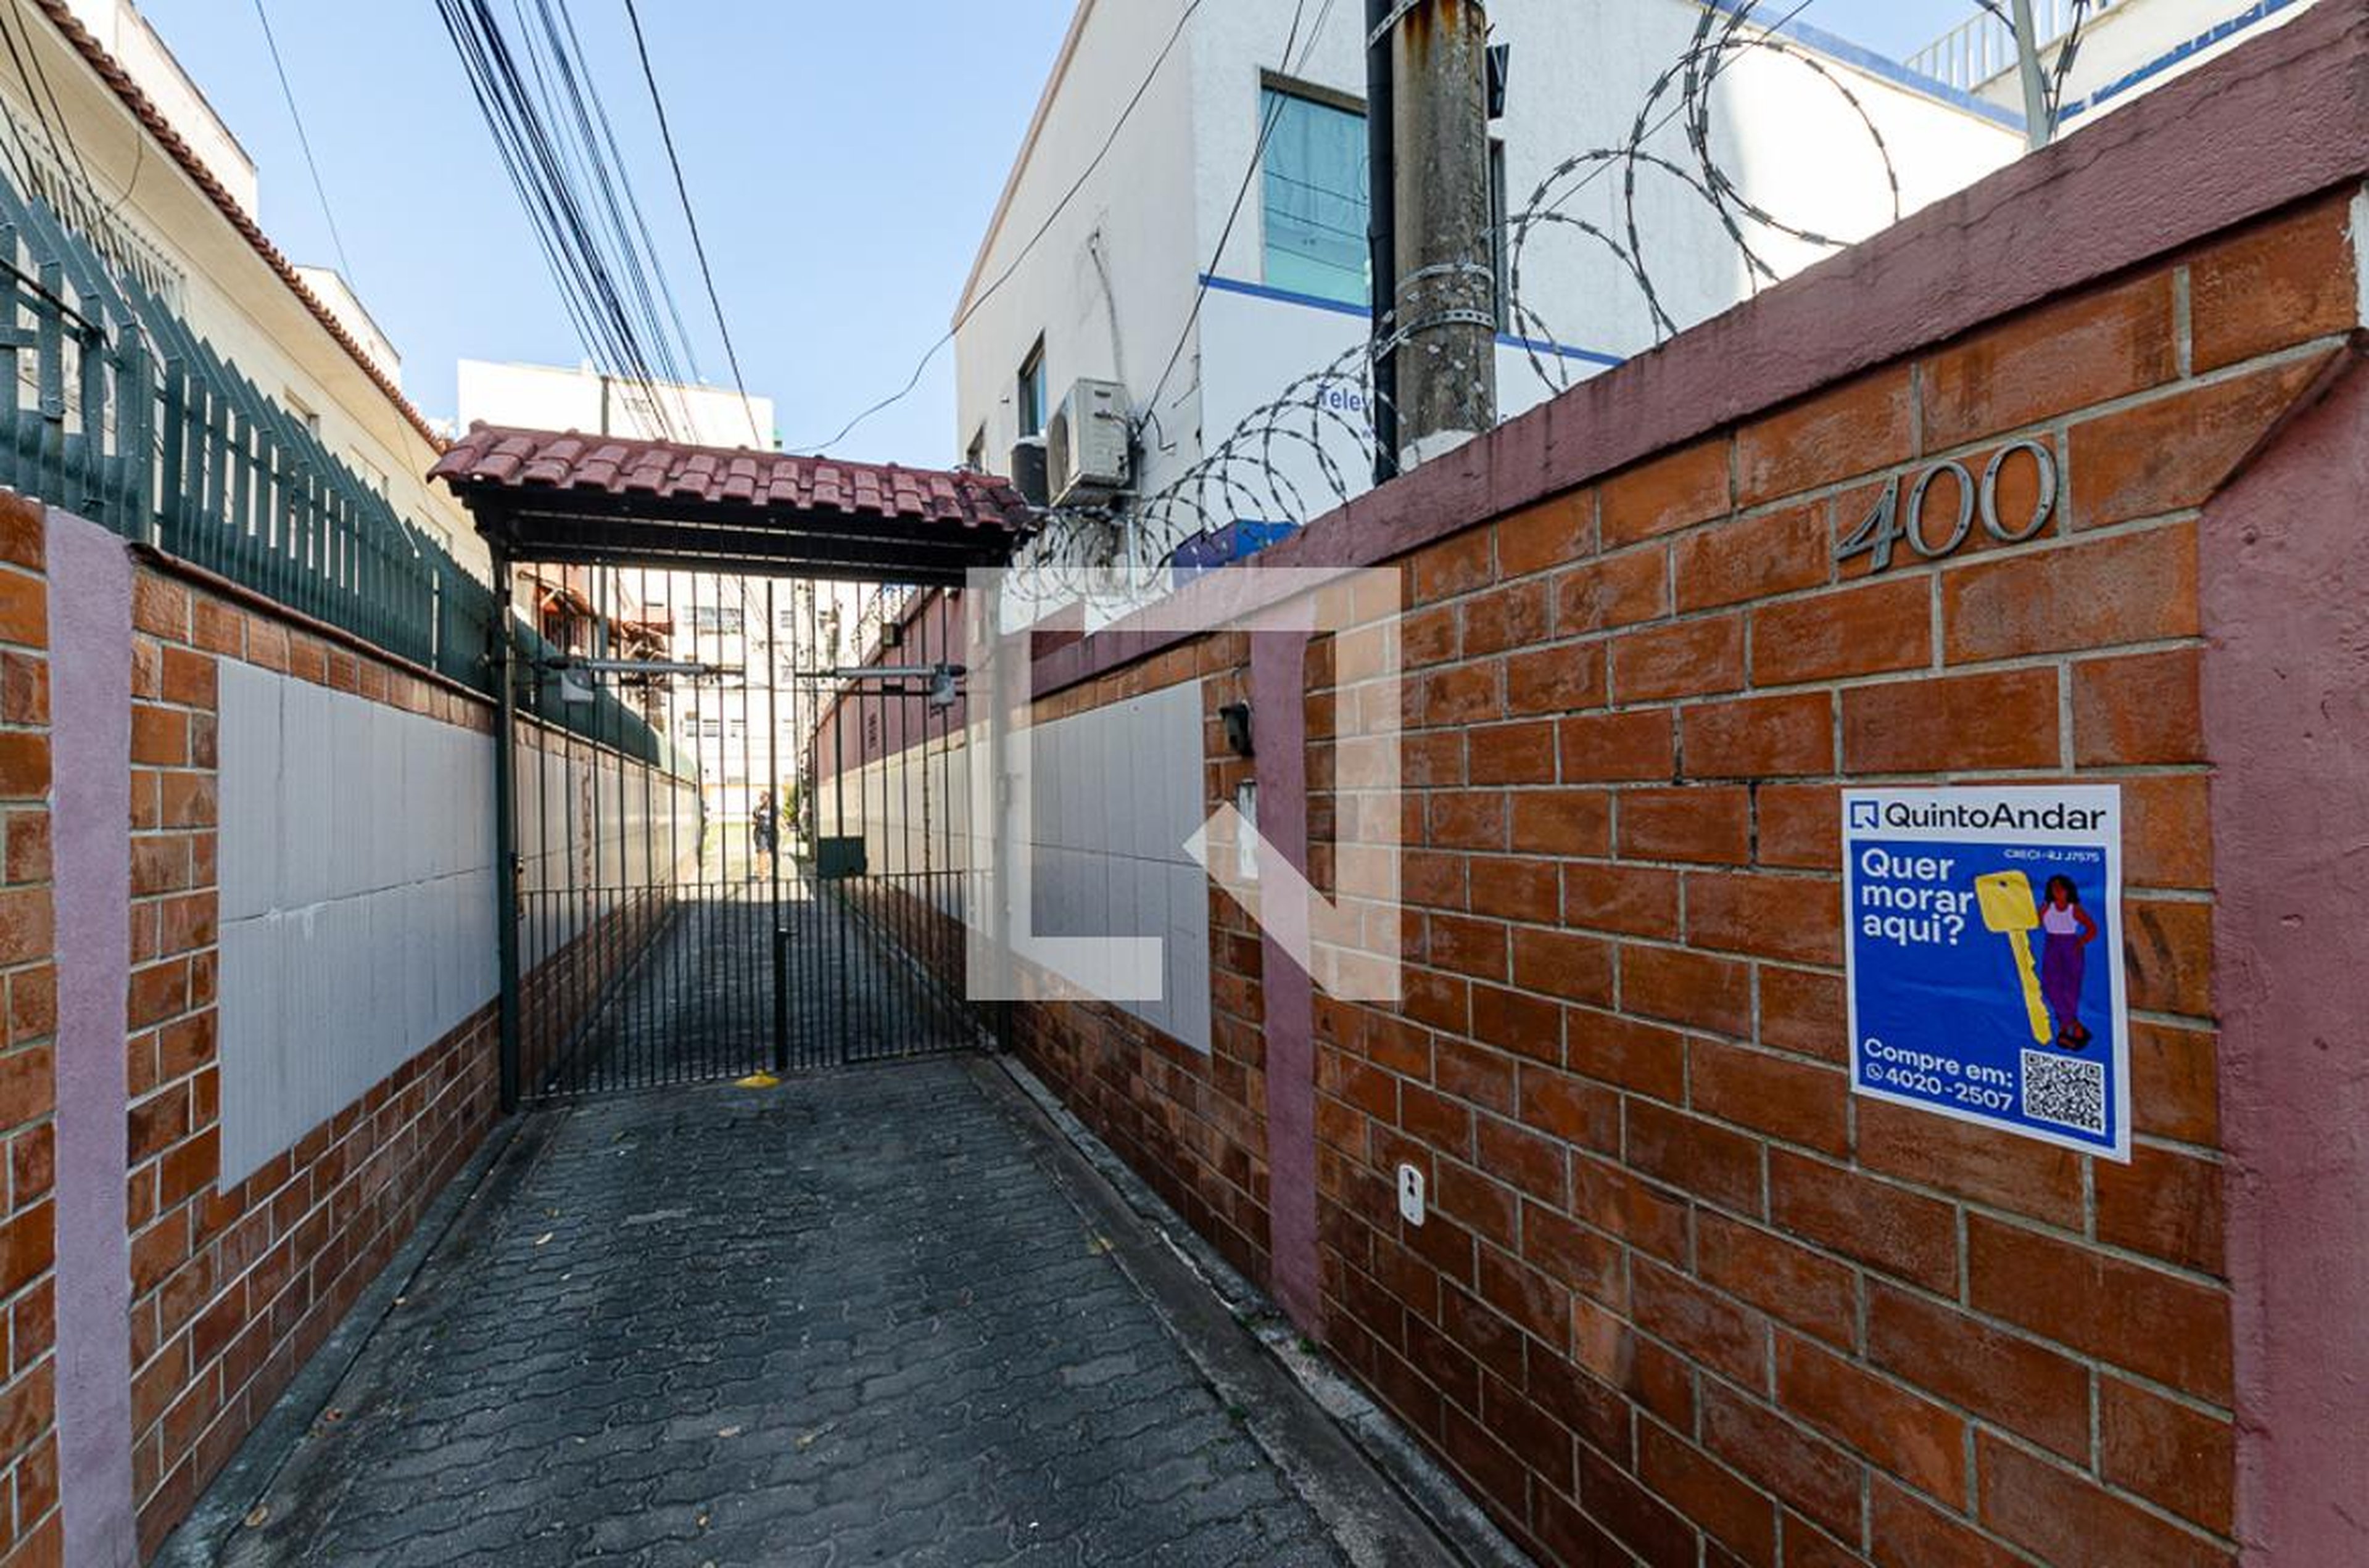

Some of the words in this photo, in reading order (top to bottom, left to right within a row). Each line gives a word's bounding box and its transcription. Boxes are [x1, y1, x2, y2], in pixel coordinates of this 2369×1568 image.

[1837, 439, 2058, 572] 400
[1885, 803, 2107, 830] QuintoAndar
[1861, 848, 1954, 881] Quer
[1862, 884, 1974, 914] morar
[1863, 914, 1965, 946] aqui?
[1864, 1038, 1961, 1076] Compre
[1966, 1063, 2013, 1087] em:
[1885, 1067, 2013, 1111] 4020-2507
